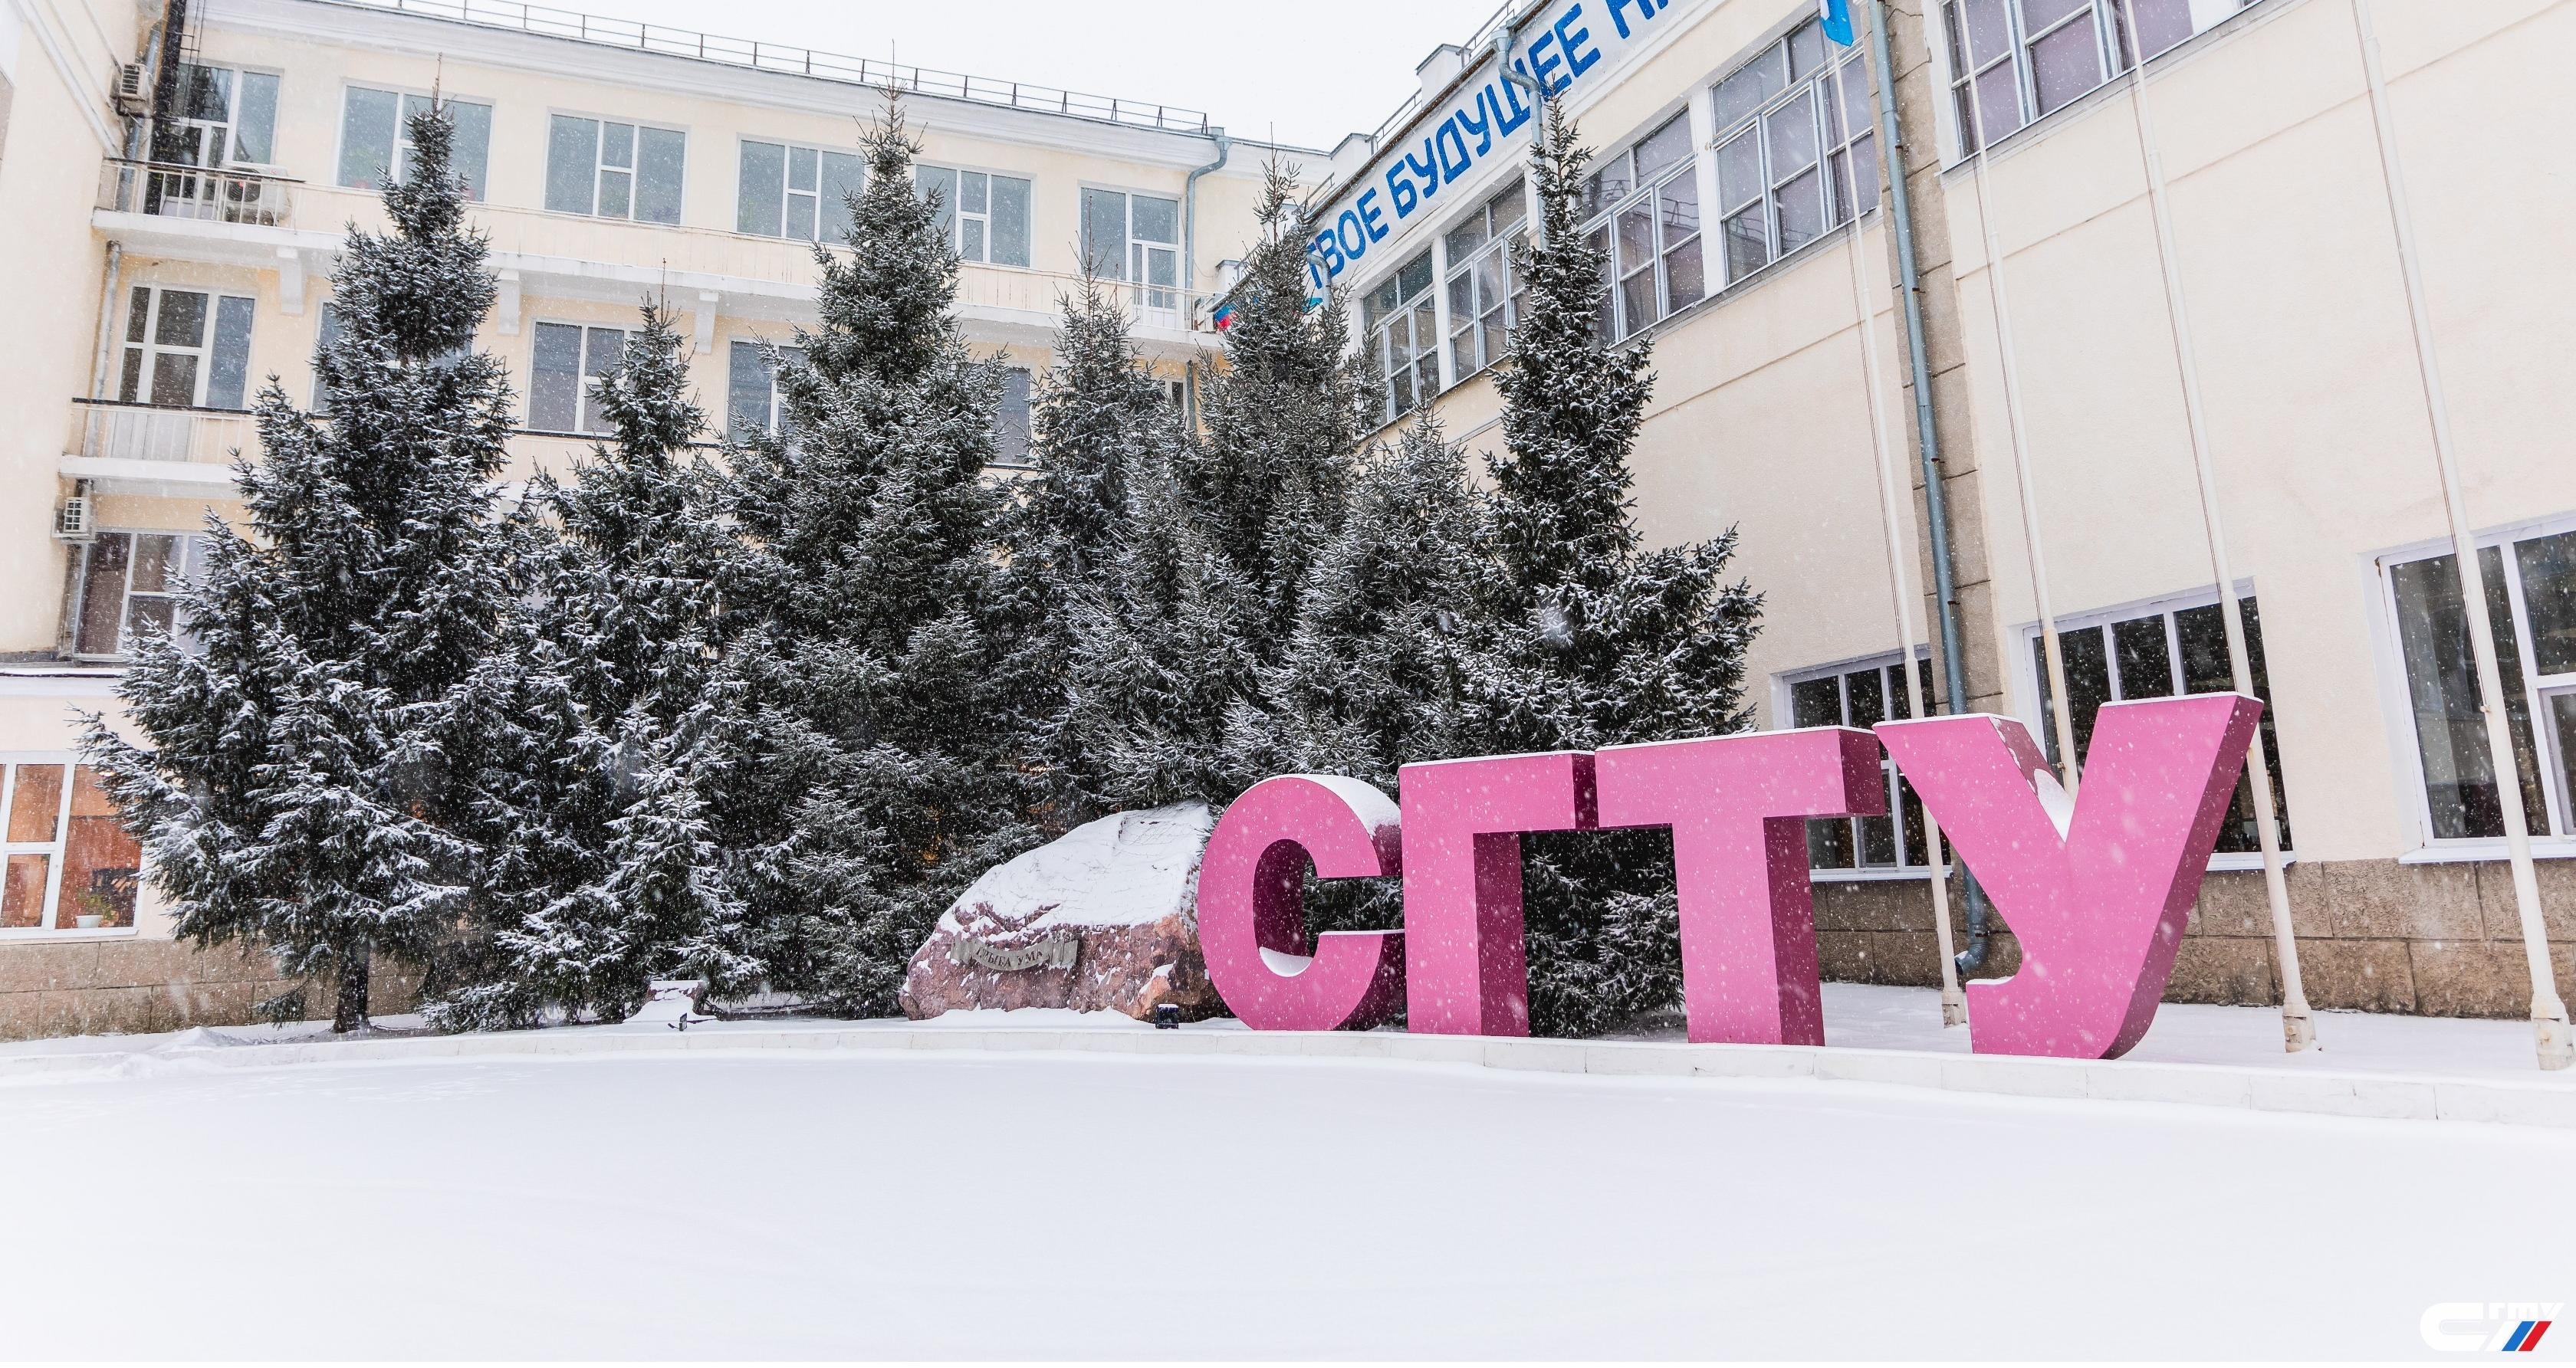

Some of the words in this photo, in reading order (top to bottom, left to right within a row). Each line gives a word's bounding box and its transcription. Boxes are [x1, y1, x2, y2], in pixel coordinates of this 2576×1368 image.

[1306, 186, 1390, 290] ТВОЕ
[1386, 2, 1602, 218] БУДУЩЕЕ
[1017, 948, 1043, 966] УМА
[1197, 692, 2265, 1060] СГТУ
